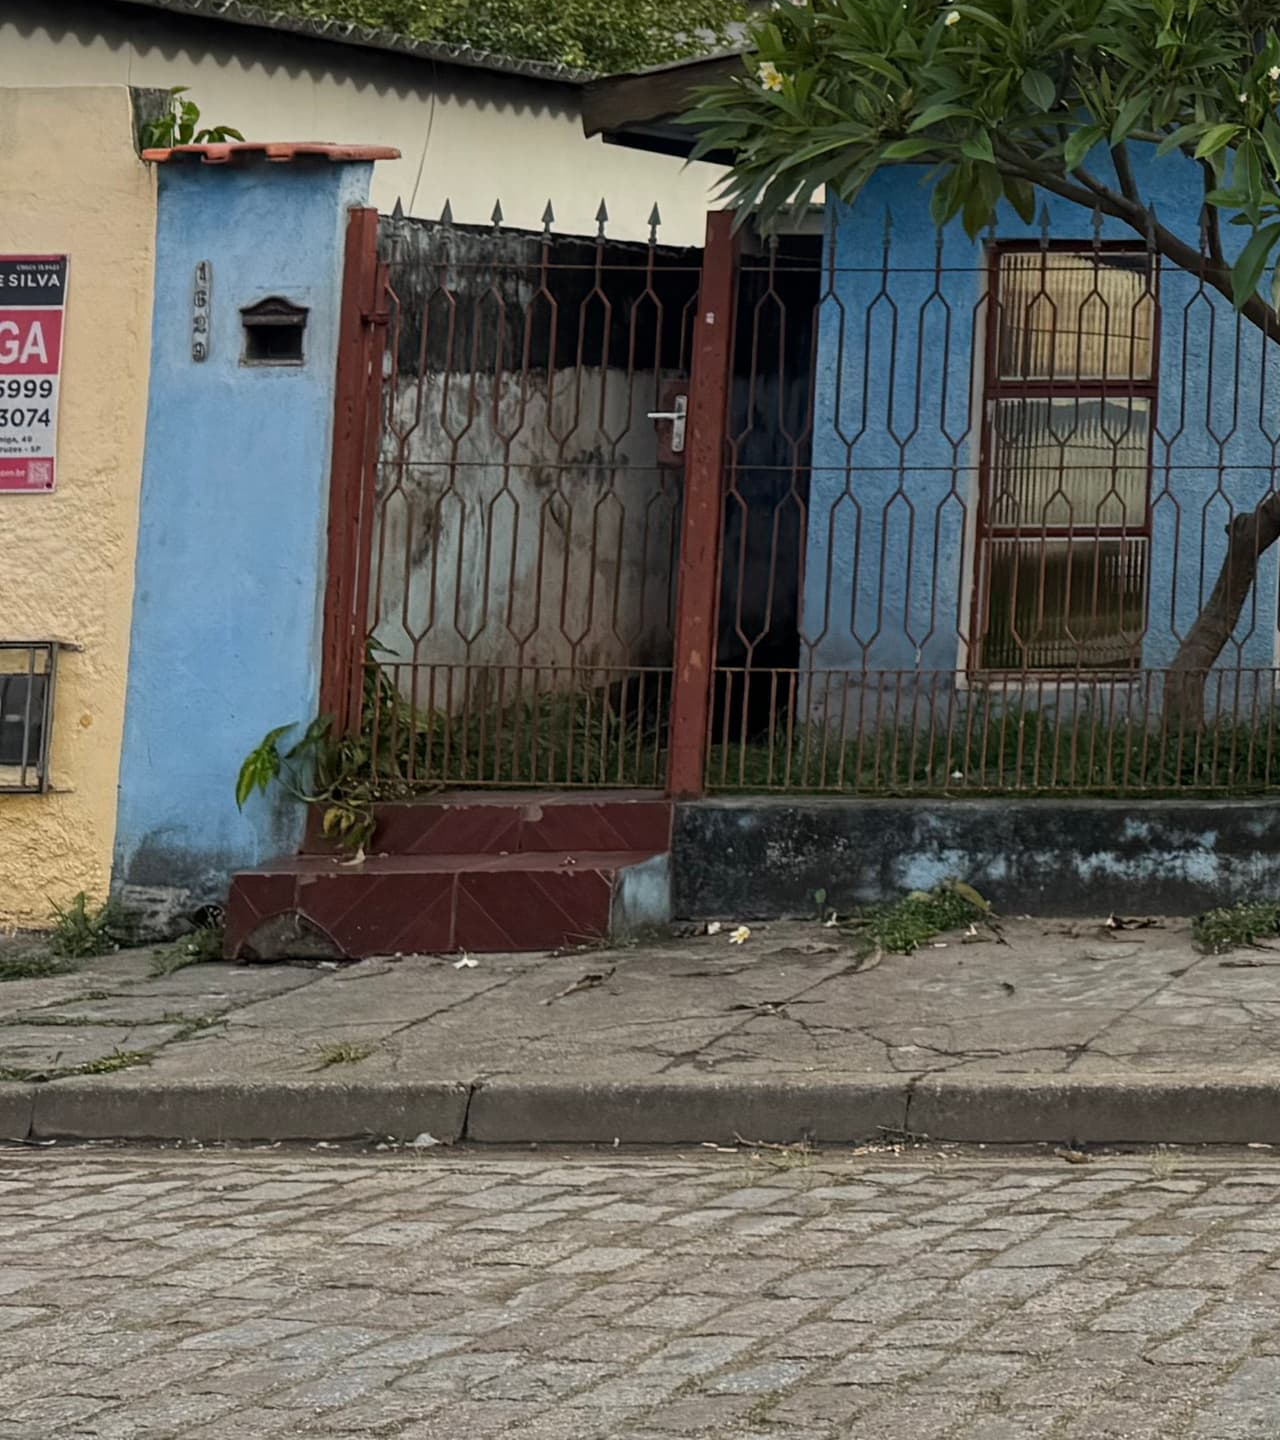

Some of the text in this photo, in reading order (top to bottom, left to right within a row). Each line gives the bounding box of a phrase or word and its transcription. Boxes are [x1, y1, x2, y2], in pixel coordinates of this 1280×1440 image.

[8, 273, 60, 288] SILVA
[0, 320, 48, 364] GA
[0, 408, 50, 428] 3074
